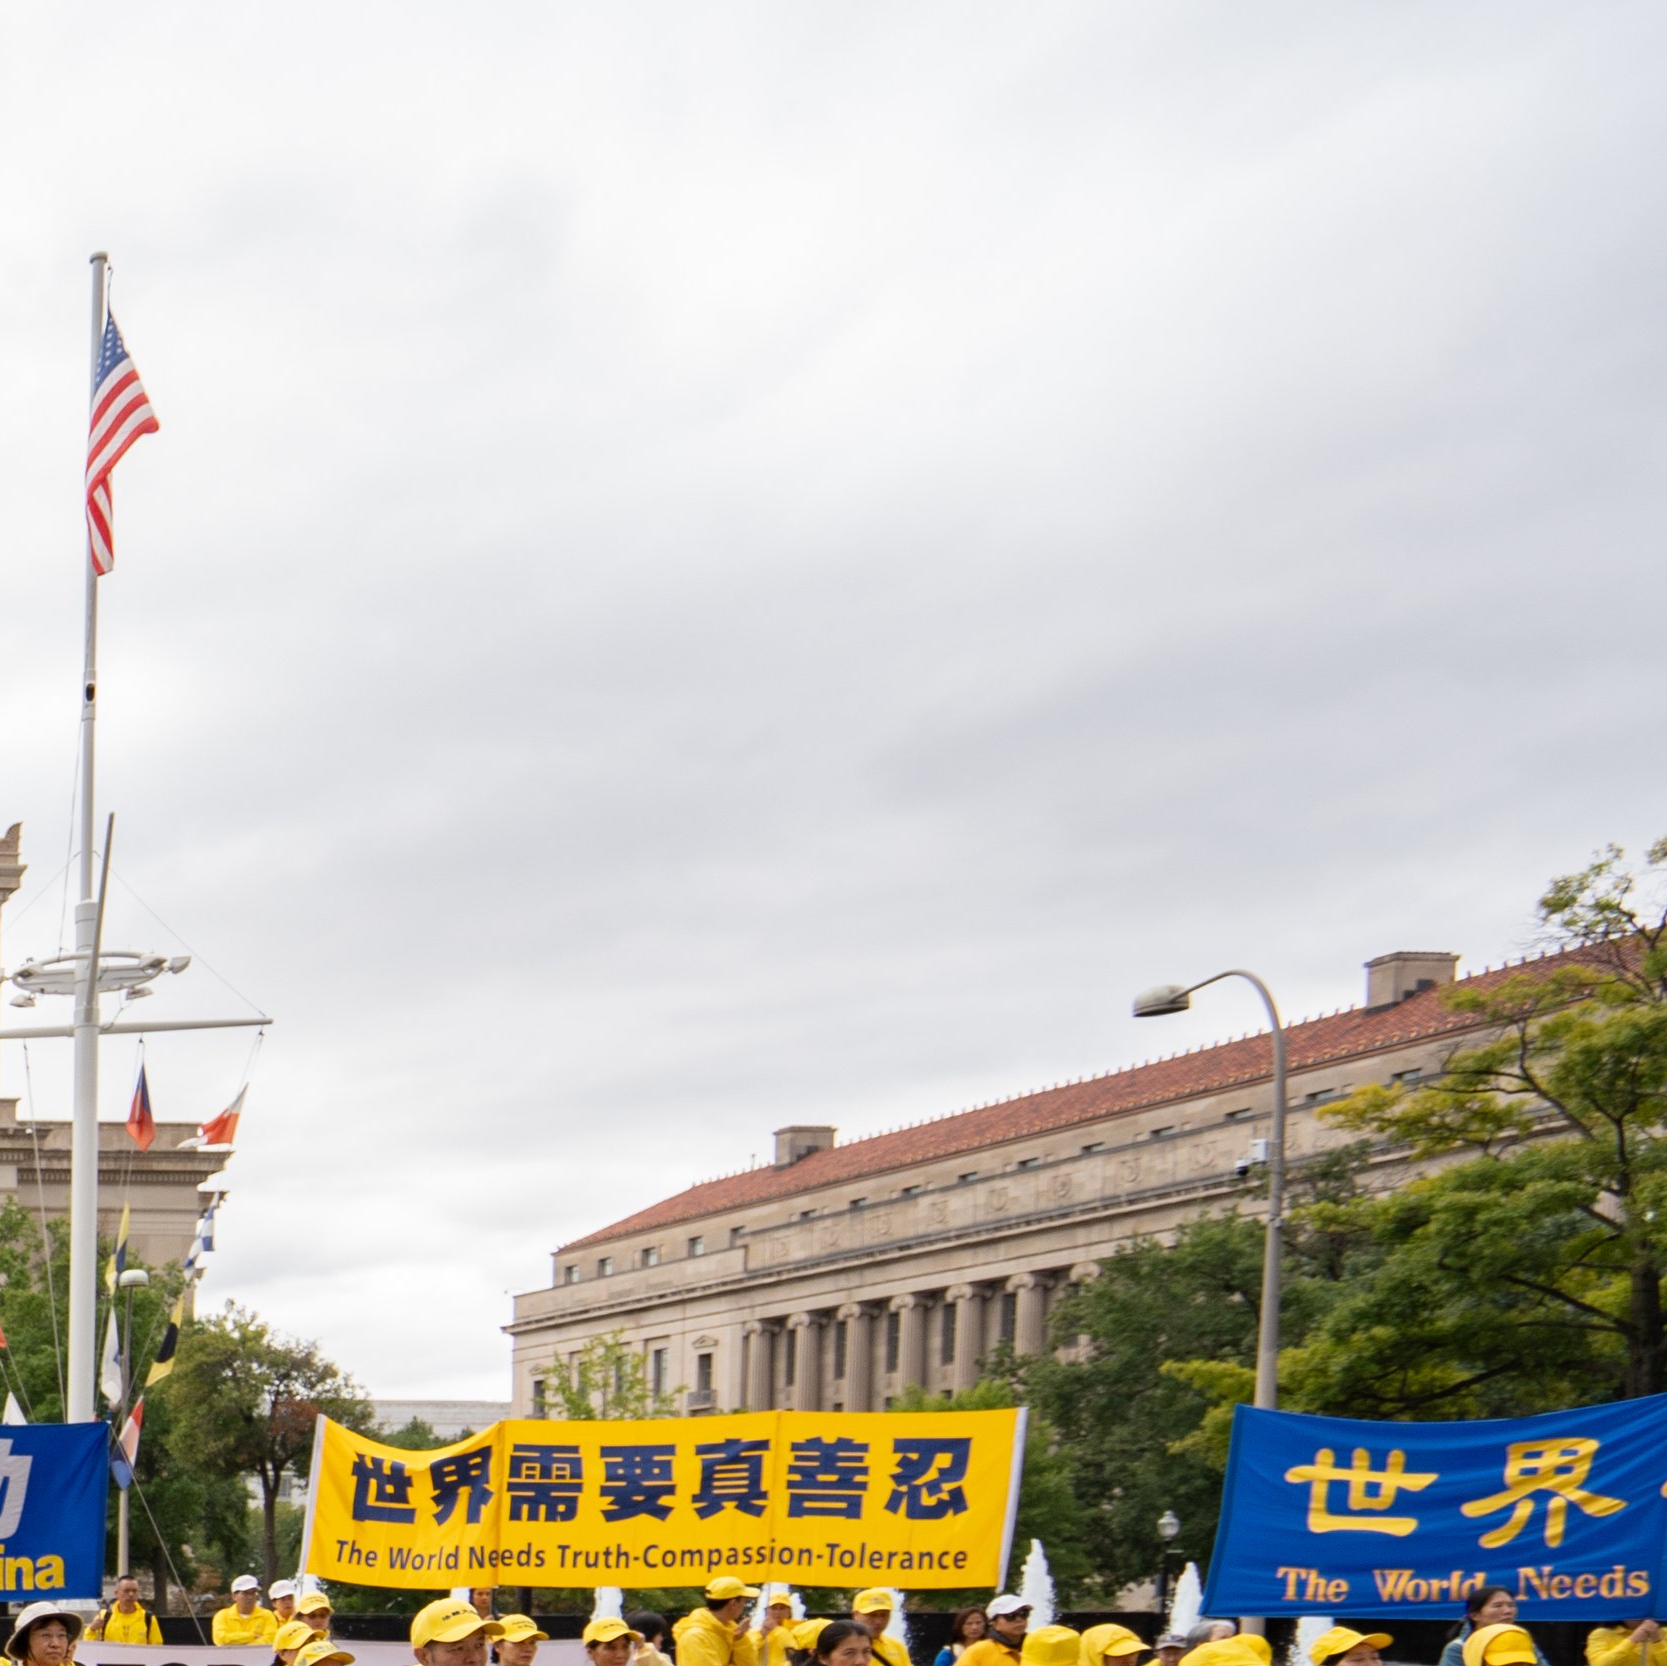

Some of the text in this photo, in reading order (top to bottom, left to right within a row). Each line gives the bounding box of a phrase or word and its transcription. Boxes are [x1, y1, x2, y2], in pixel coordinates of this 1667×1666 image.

[350, 1436, 973, 1526] 世界需要真善忍
[1283, 1436, 1667, 1550] 世界
[335, 1539, 968, 1573] The World Needs Truth-Compassion-Tolerance
[1276, 1564, 1651, 1602] The World Needs
